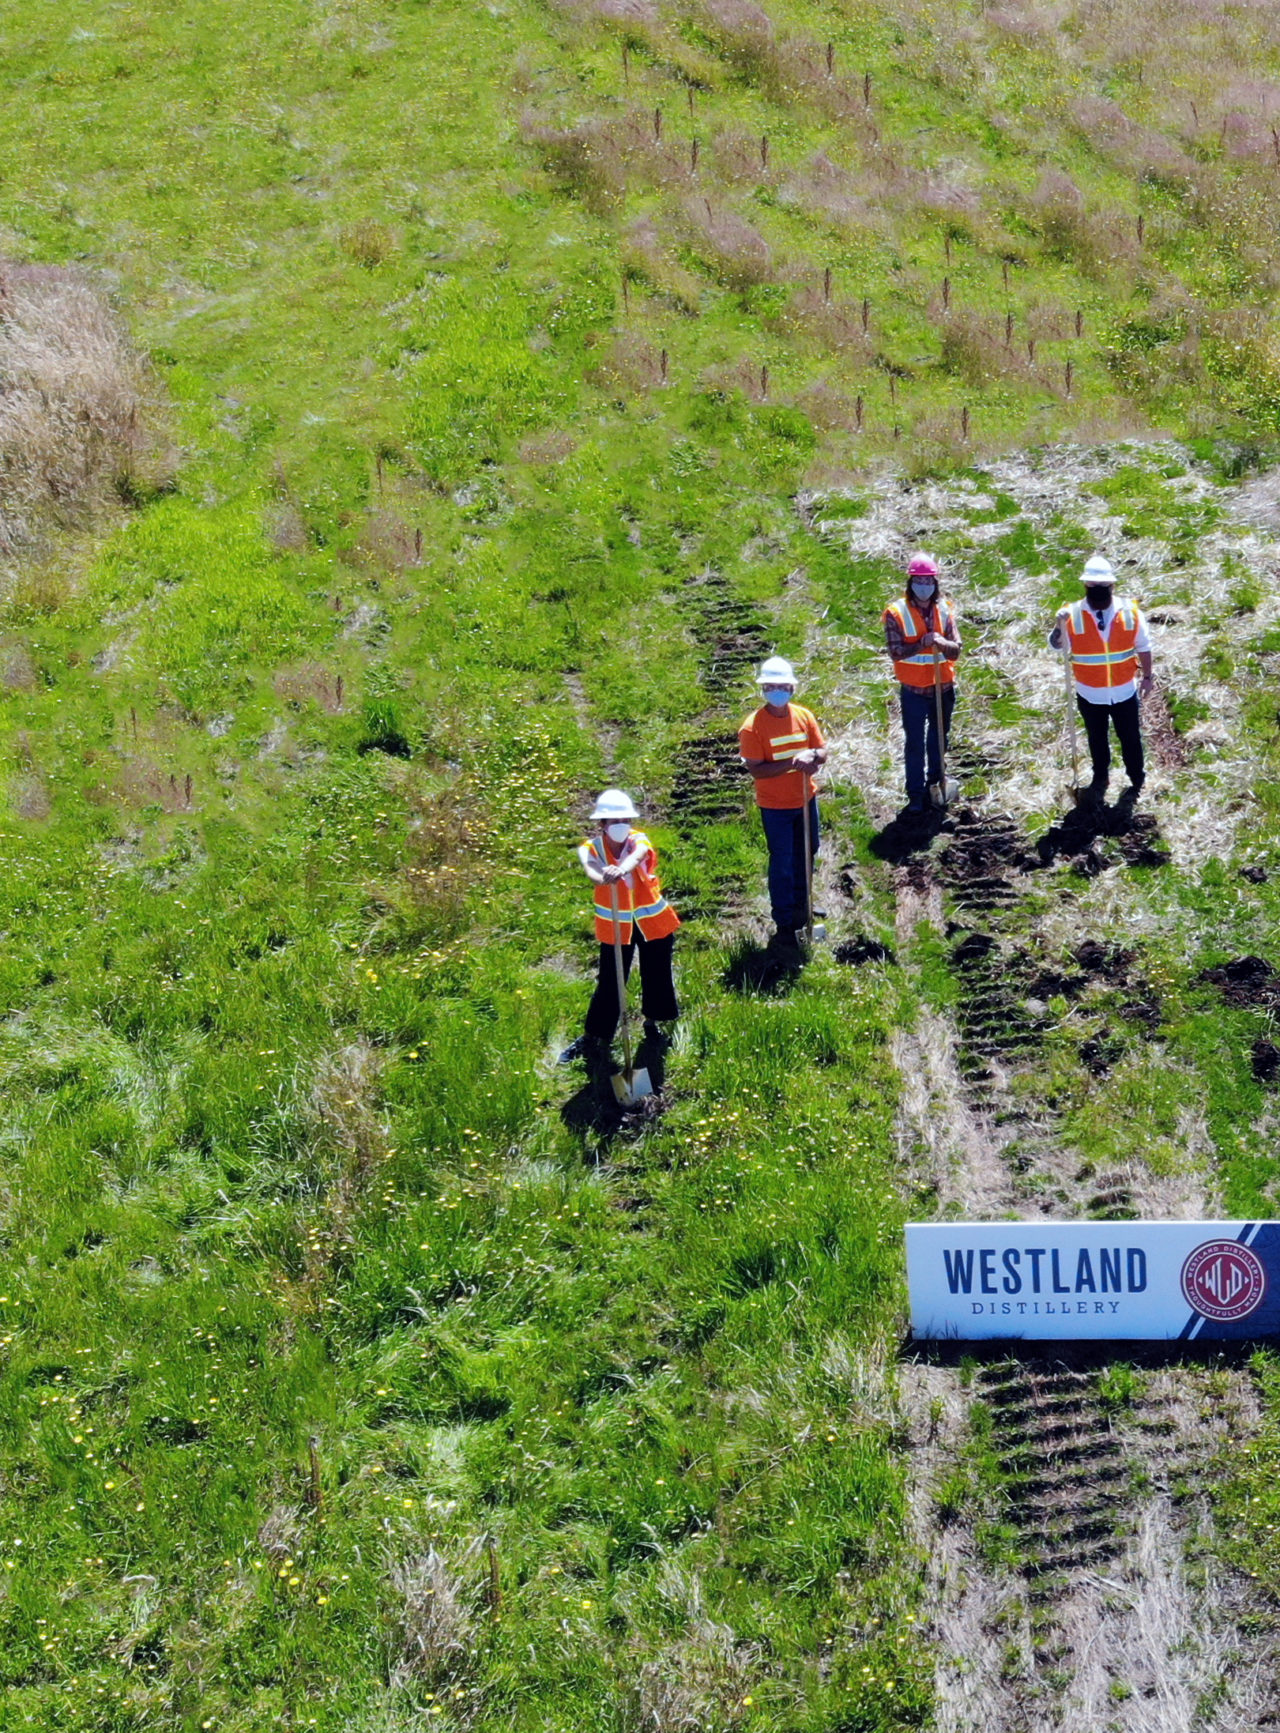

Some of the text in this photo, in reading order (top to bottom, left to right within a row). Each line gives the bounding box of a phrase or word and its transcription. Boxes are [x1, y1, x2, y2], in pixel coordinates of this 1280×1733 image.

[943, 1247, 1147, 1294] WESTLAND
[1187, 1246, 1260, 1279] WESTLAND DISTILLERY
[971, 1301, 1121, 1315] DISTILLERY
[1188, 1286, 1259, 1316] THOUGHTFULLY MADE
